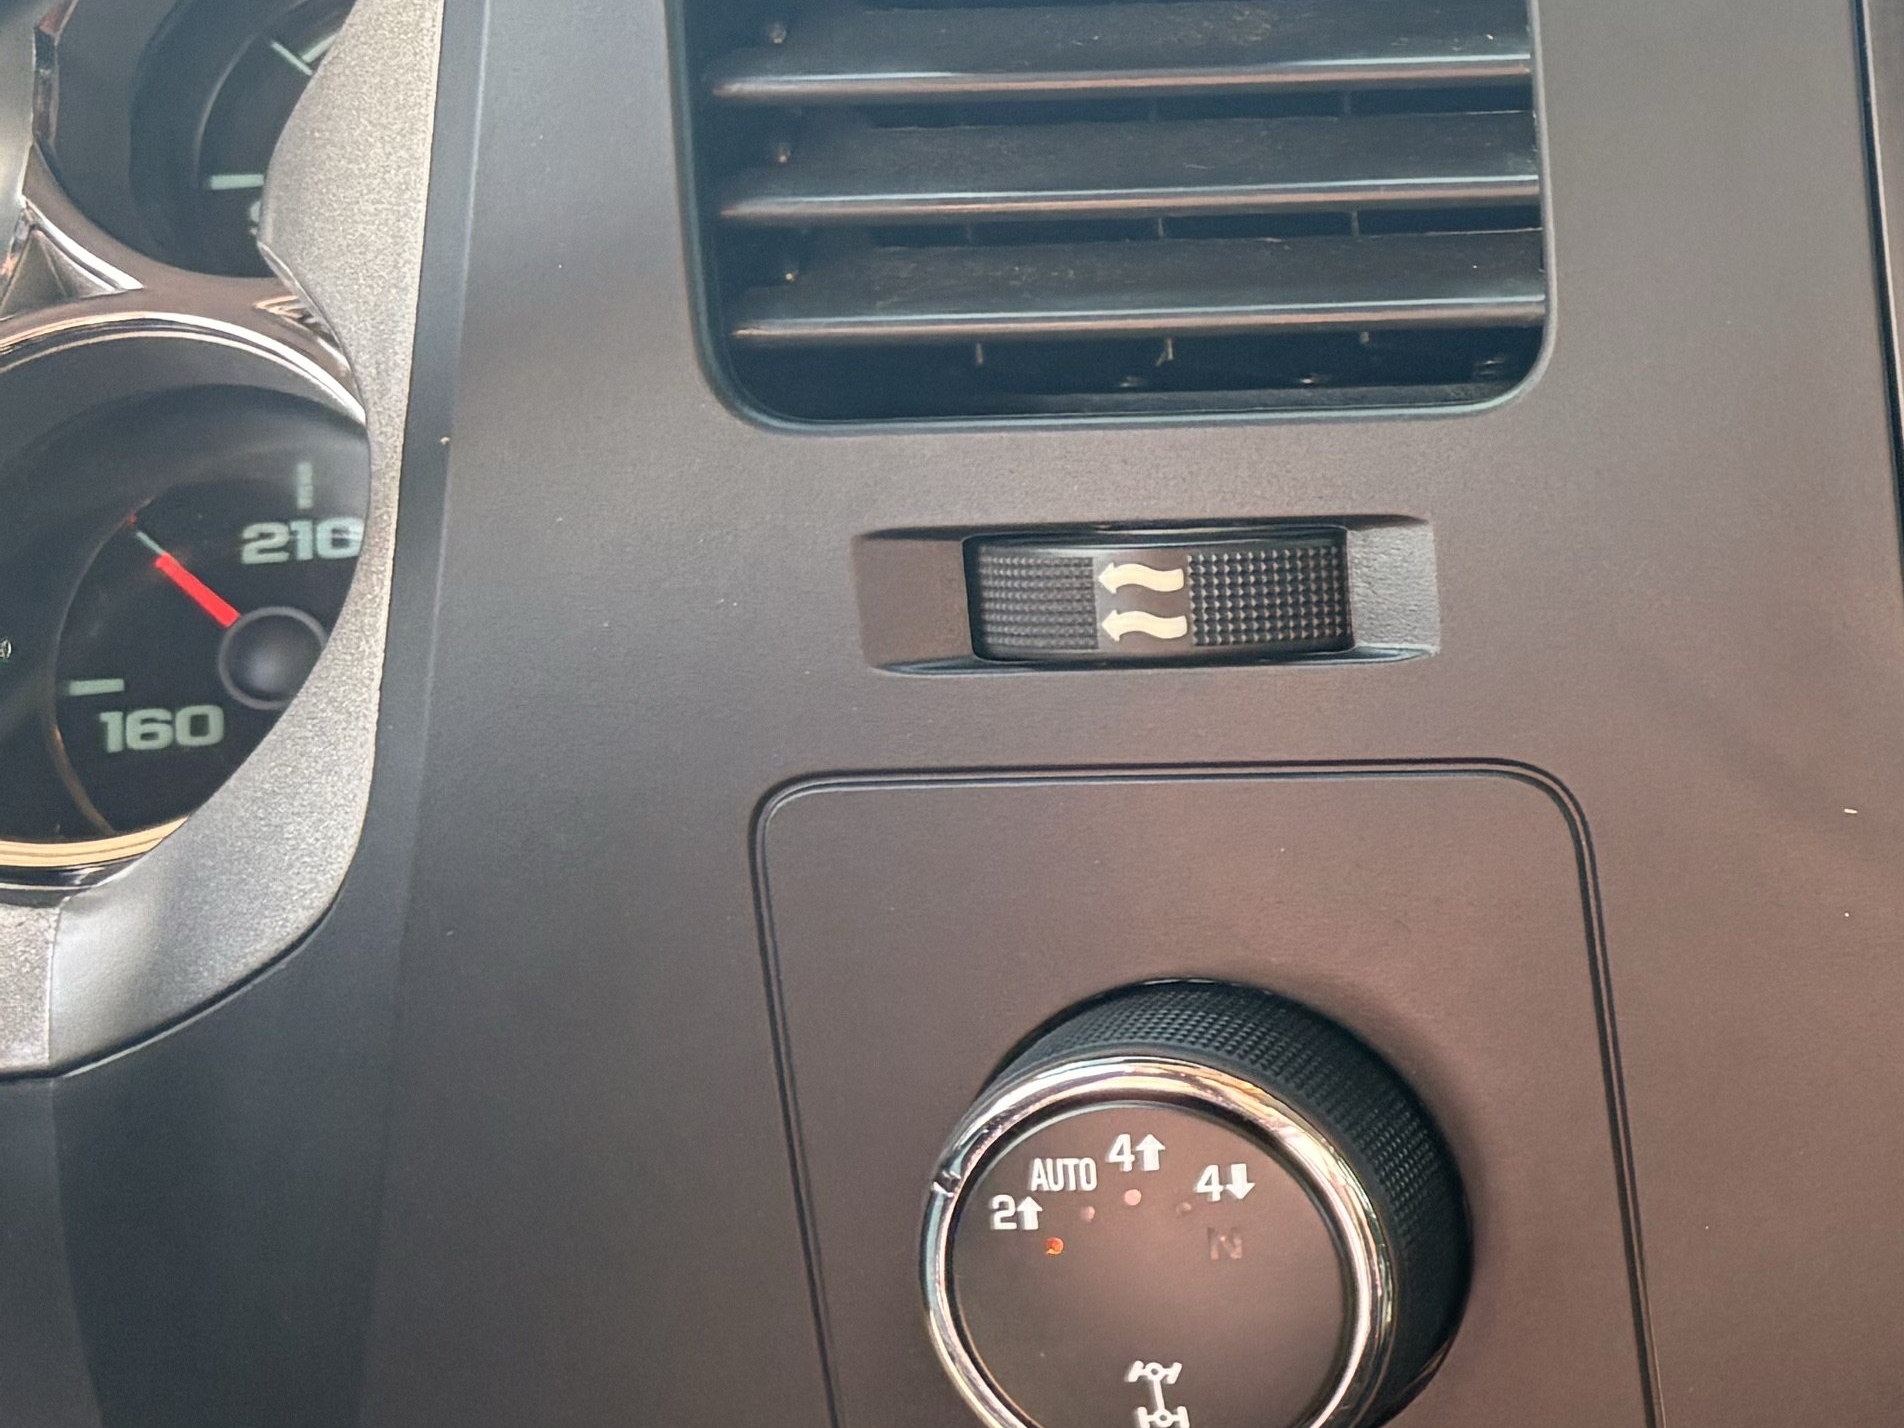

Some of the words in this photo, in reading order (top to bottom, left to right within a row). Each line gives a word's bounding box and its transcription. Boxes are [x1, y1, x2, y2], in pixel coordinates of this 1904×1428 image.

[242, 517, 364, 564] 210
[99, 705, 224, 753] 160
[1107, 1133, 1136, 1172] 4
[1030, 1157, 1098, 1192] AUTO
[1194, 1164, 1224, 1202] 4
[991, 1194, 1018, 1230] 2
[1207, 1226, 1243, 1260] N
